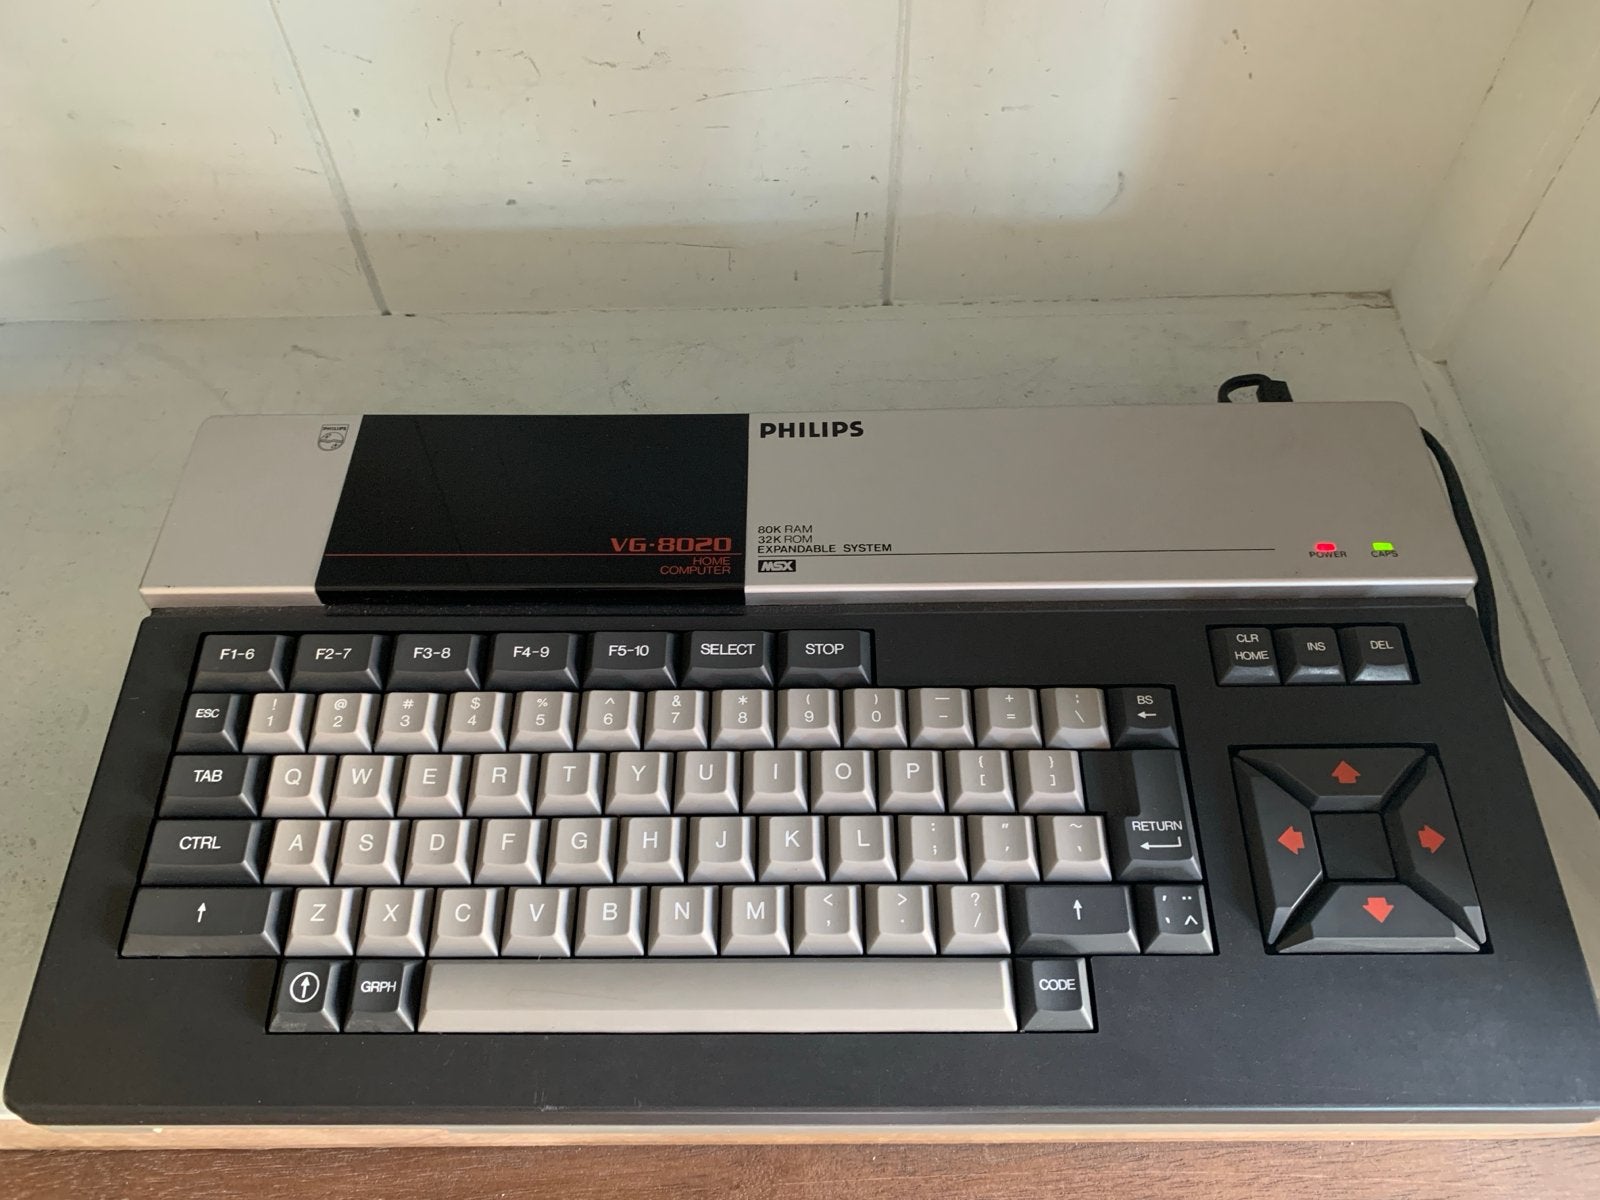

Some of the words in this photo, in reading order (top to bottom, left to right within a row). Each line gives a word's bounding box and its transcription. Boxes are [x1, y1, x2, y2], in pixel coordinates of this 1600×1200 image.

[759, 420, 864, 439] PHILIPS
[757, 525, 782, 534] 80K
[784, 525, 813, 534] RAM
[610, 537, 732, 552] VG-8020
[757, 535, 782, 544] 32K
[784, 535, 813, 544] ROM
[757, 544, 837, 554] EXPANDABLE
[843, 543, 892, 553] SYSTEM
[1308, 550, 1348, 558] POWER
[1370, 550, 1399, 558] CAPS
[693, 556, 730, 565] HOME
[760, 561, 794, 572] MSX
[660, 566, 731, 575] COMPUTER
[1236, 633, 1259, 643] CLR
[608, 645, 650, 656] F5-10
[700, 643, 756, 655] SELECT
[805, 643, 845, 655] STOP
[1306, 642, 1327, 651] INS
[1369, 640, 1394, 650] DEL
[219, 648, 255, 660] F1-6
[315, 648, 352, 660] F2-7
[412, 647, 451, 659] F3-8
[513, 646, 550, 658] F4-9
[1234, 651, 1270, 661] HOME
[1136, 695, 1154, 705] BS
[195, 708, 220, 718] ESC
[603, 713, 613, 725] 6
[671, 712, 680, 724] 7
[737, 712, 748, 724] 8
[804, 710, 814, 723] 9
[266, 715, 274, 727] 1
[333, 716, 343, 728] 2
[399, 715, 410, 727] 3
[467, 715, 477, 726] 4
[535, 714, 545, 726] 5
[193, 769, 223, 782] TAB
[284, 768, 302, 786] Q
[351, 768, 373, 785] W
[422, 767, 437, 785] E
[491, 766, 507, 784] R
[563, 765, 576, 782] T
[631, 765, 647, 782] Y
[700, 764, 714, 780] U
[773, 763, 778, 780] I
[835, 762, 852, 780] O
[906, 763, 920, 779] P
[1132, 821, 1183, 831] RETURN
[179, 836, 221, 850] CTRL
[288, 834, 303, 851] A
[359, 834, 374, 851] S
[429, 833, 446, 851] D
[500, 833, 516, 851] F
[570, 831, 588, 849] G
[643, 831, 658, 849] H
[715, 830, 727, 848] J
[785, 830, 800, 847] K
[857, 829, 870, 847] L
[310, 904, 327, 922] Z
[382, 904, 400, 922] X
[454, 903, 471, 922] C
[530, 903, 545, 922] V
[602, 902, 618, 921] B
[674, 901, 690, 920] N
[746, 901, 765, 920] M
[360, 981, 397, 993] GRPH
[1039, 978, 1077, 991] CODE
